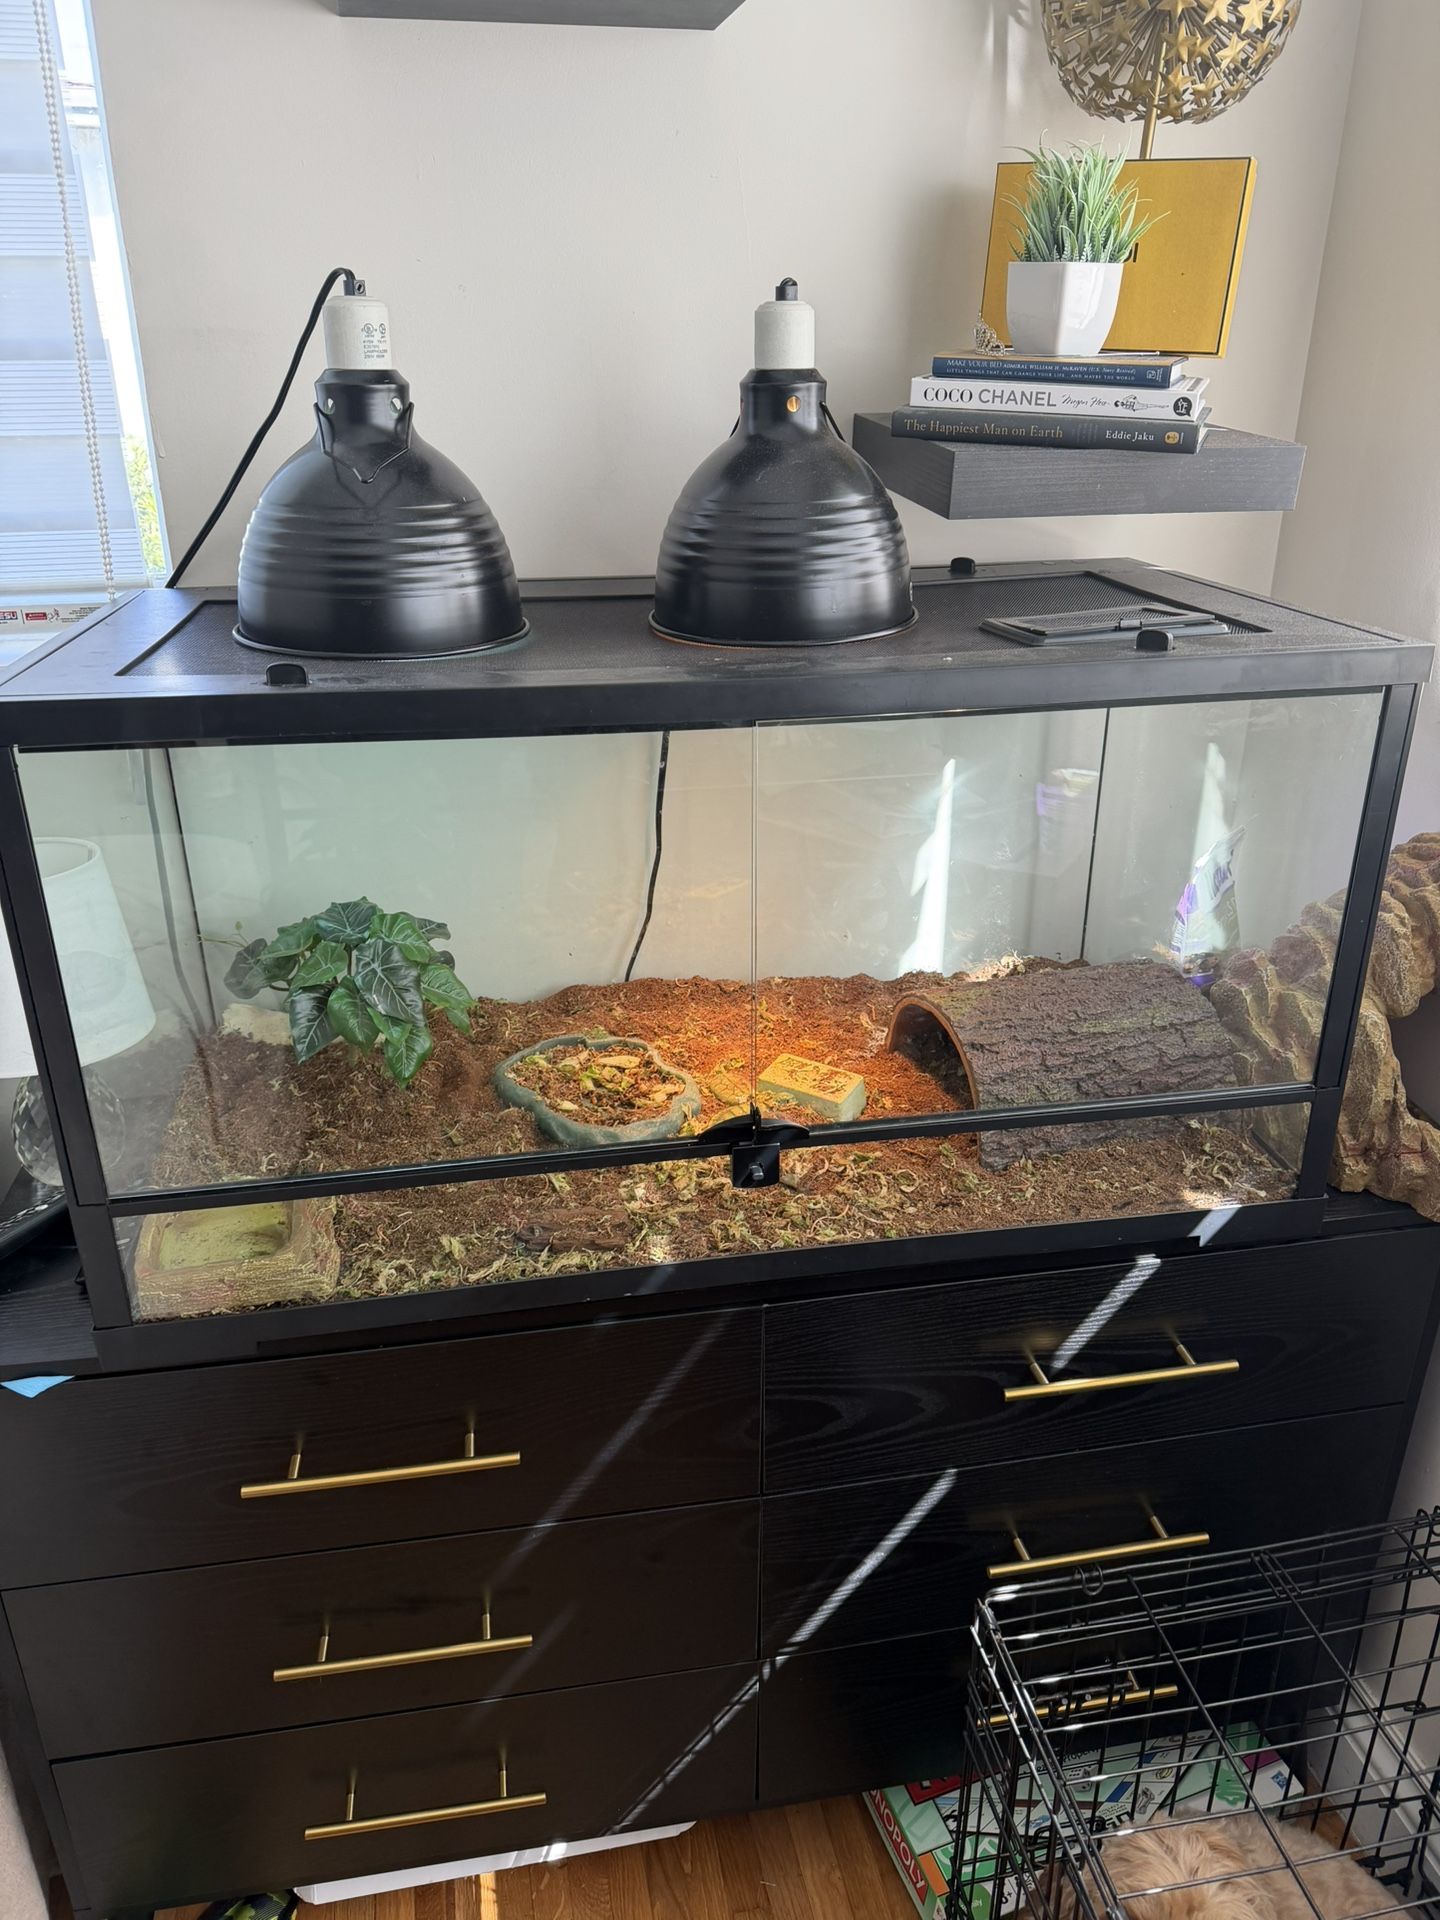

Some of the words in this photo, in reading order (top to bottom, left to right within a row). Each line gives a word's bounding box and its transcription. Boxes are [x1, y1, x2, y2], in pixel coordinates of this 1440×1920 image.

[946, 359, 966, 367] MAKE
[968, 360, 988, 368] YOUR
[989, 360, 1002, 368] BED
[923, 387, 973, 403] COCO
[978, 388, 1057, 407] CHANEL
[904, 418, 927, 432] The
[930, 420, 979, 435] Happiest
[982, 422, 1008, 435] Man
[1011, 427, 1026, 436] on
[1030, 425, 1063, 438] Earth
[1105, 430, 1132, 440] Eddie
[1132, 431, 1155, 442] Jaku
